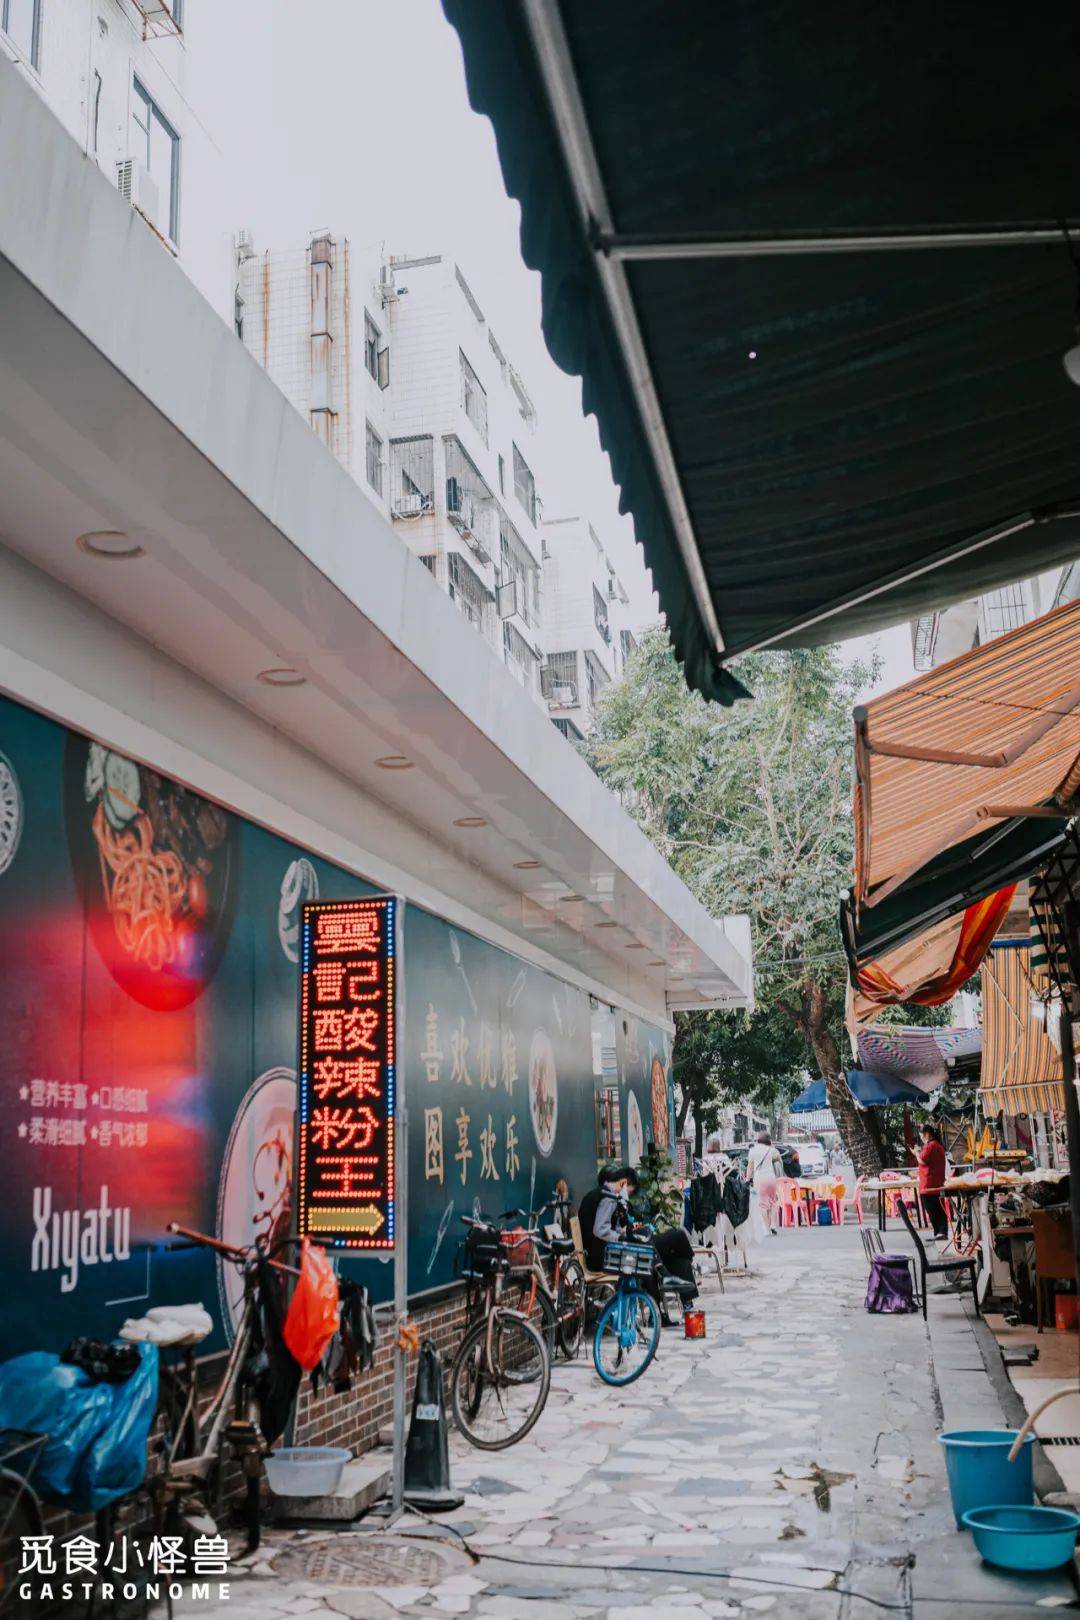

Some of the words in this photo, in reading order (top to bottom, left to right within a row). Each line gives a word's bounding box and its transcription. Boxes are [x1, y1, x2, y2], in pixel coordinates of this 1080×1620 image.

[30, 1079, 88, 1110] 营养丰富
[311, 911, 382, 1199] 雲記酸辣粉王
